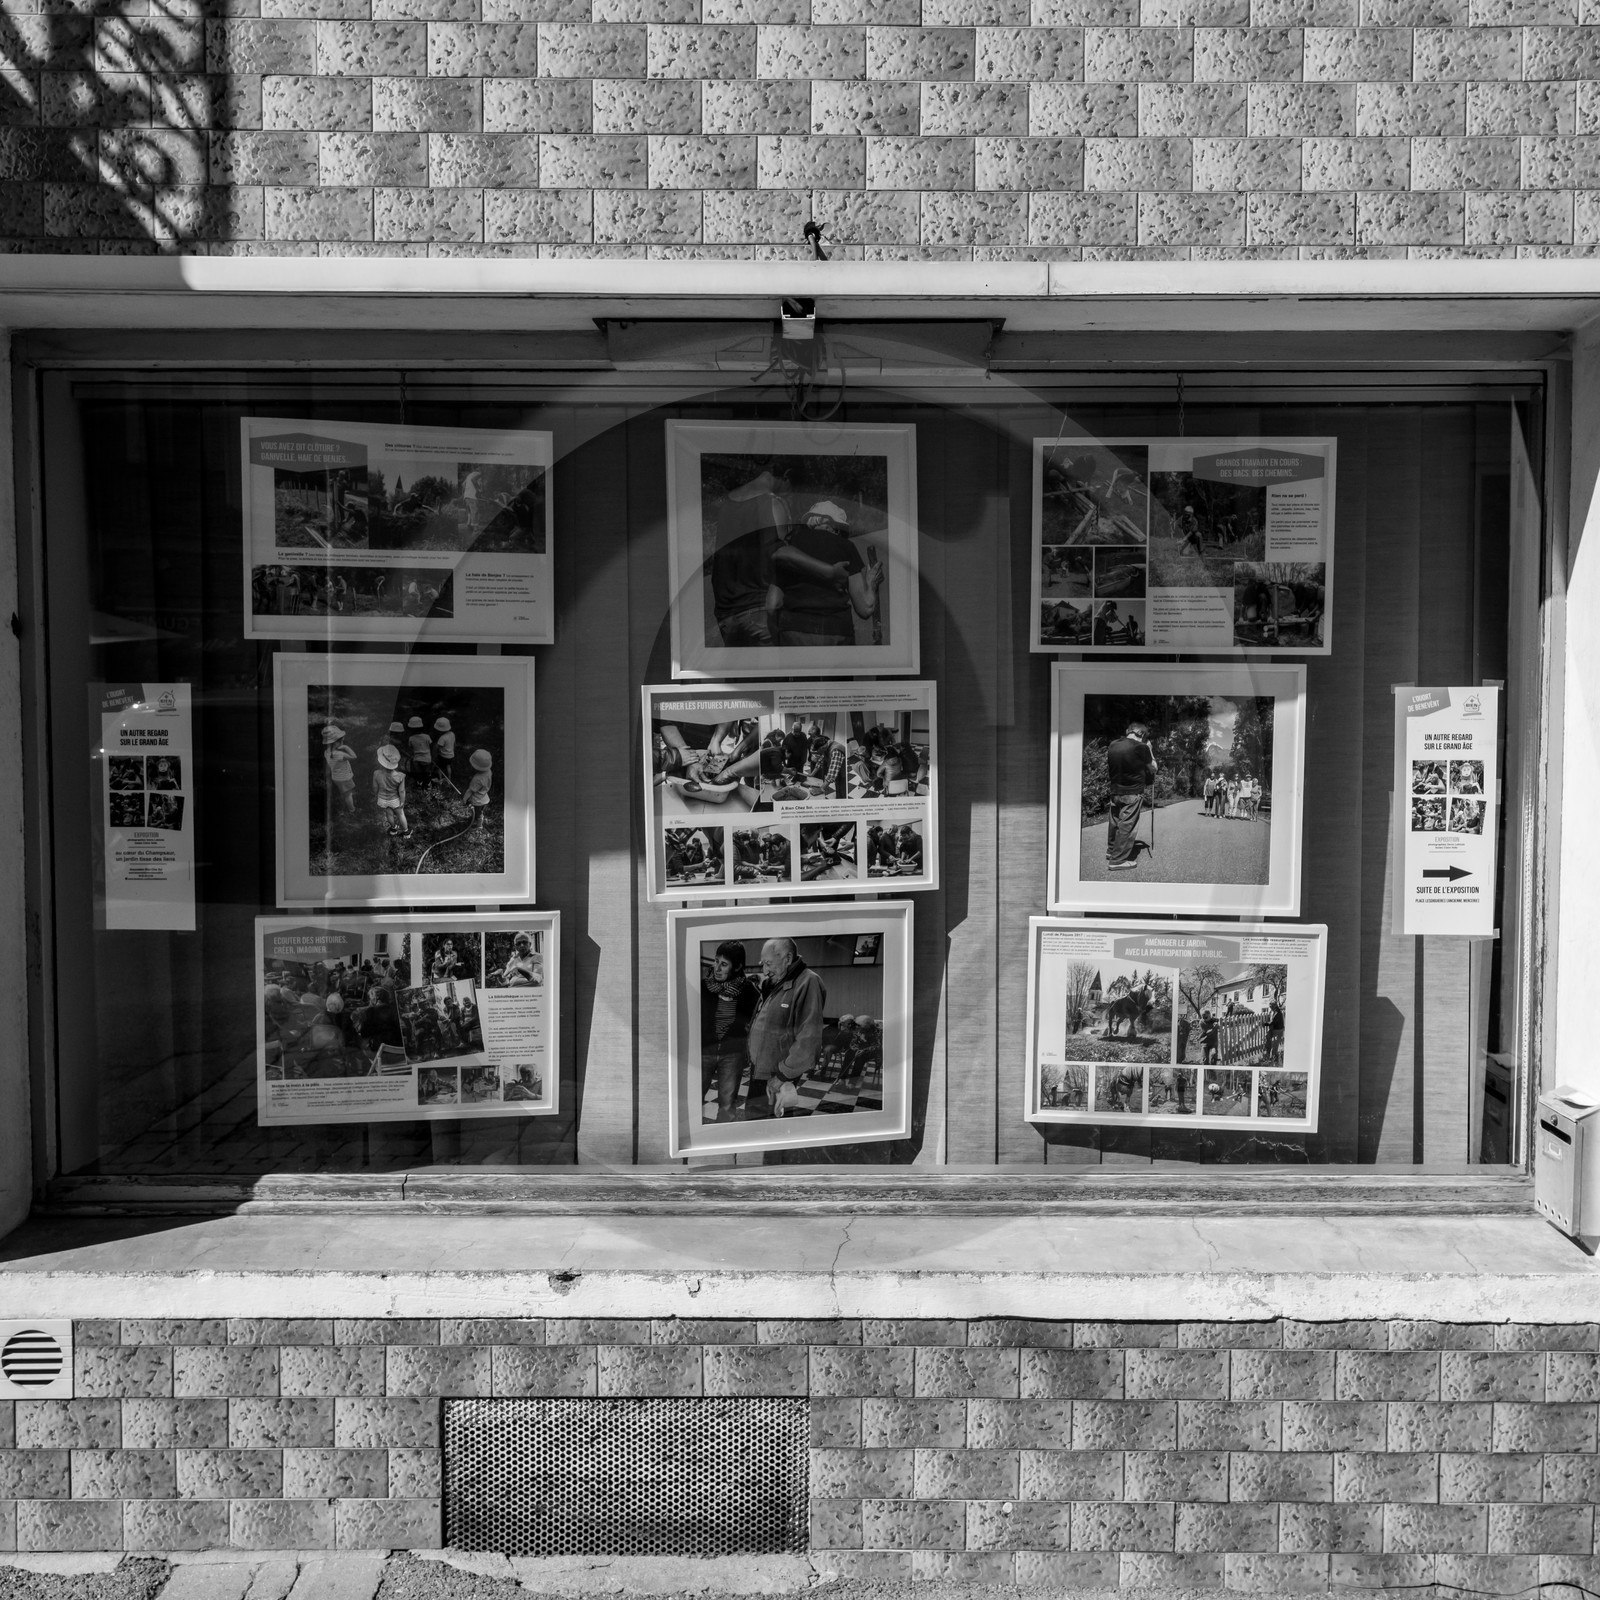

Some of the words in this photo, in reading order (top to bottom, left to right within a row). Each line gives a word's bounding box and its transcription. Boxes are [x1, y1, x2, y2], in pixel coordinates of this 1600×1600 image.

[261, 441, 277, 450] VOUS
[279, 442, 295, 450] AVEZ
[296, 443, 306, 451] DIT
[298, 453, 311, 462] HAIE
[313, 454, 321, 462] DE
[1216, 458, 1240, 467] GRANDS
[1241, 458, 1268, 467] TRAVAUX
[1270, 458, 1278, 467] EN
[1279, 458, 1299, 467] COURS
[1220, 469, 1232, 477] DES
[1252, 469, 1263, 477] DES
[102, 700, 108, 708] DE
[685, 701, 696, 710] LES
[697, 701, 723, 709] FUTURES
[1407, 704, 1414, 712] DE
[1416, 886, 1432, 894] SUITE
[302, 936, 314, 944] DES
[1145, 937, 1177, 946] AMÉNAGER
[1178, 939, 1185, 947] LE
[1125, 948, 1140, 956] AVEC
[1141, 948, 1148, 956] LA
[1149, 949, 1191, 957] PARTICIPATION
[1193, 949, 1200, 957] DU
